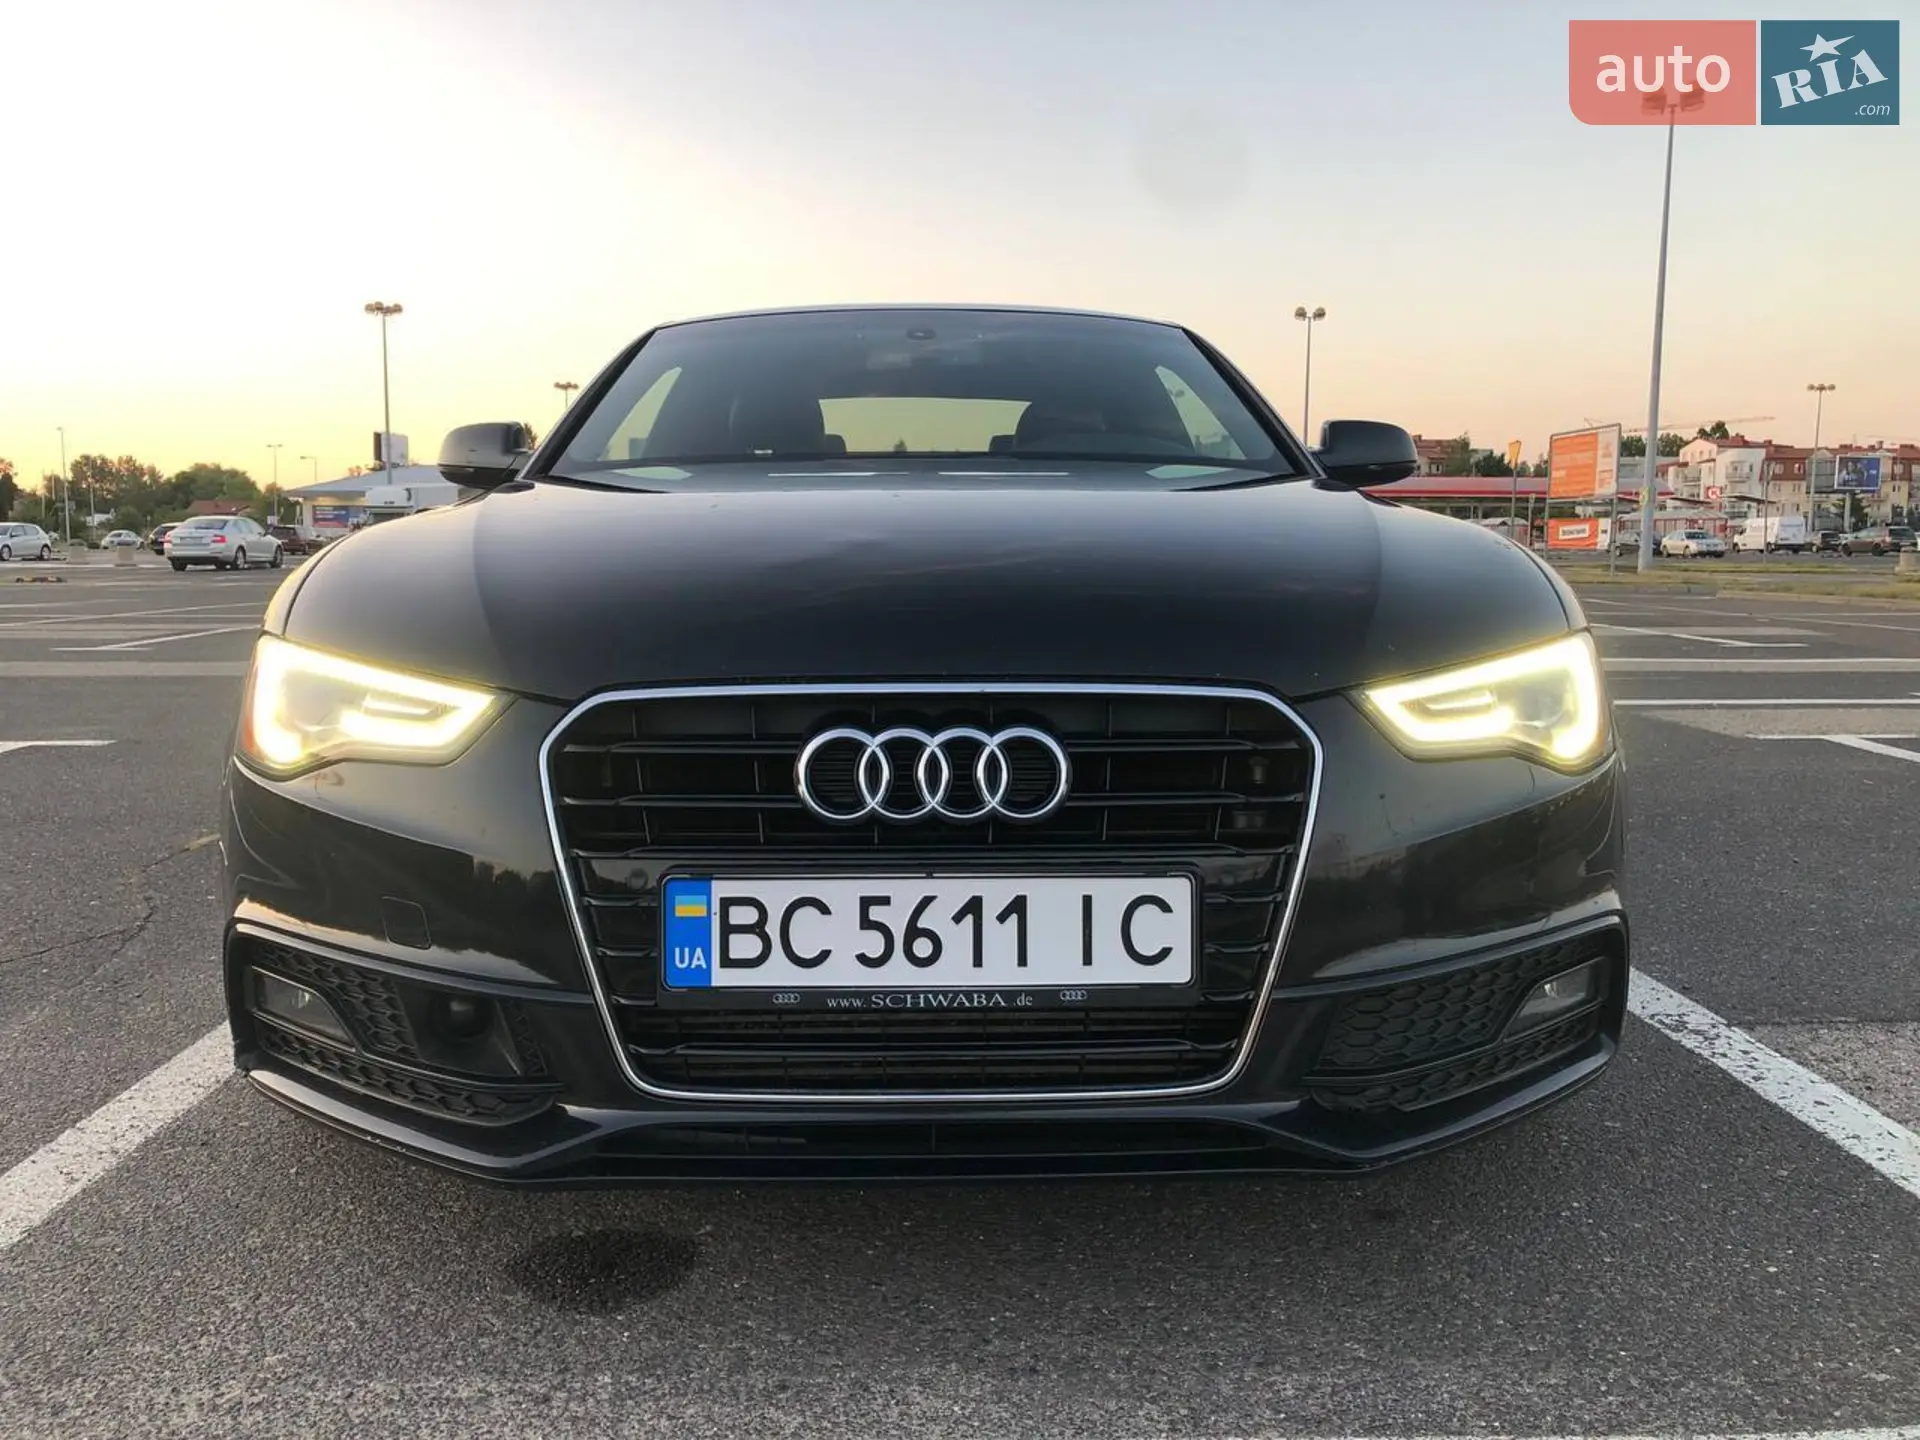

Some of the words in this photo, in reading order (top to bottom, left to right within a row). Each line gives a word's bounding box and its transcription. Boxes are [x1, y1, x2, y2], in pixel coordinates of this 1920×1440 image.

[718, 895, 833, 970] BC
[854, 895, 1029, 970] 5611
[675, 947, 707, 970] UA
